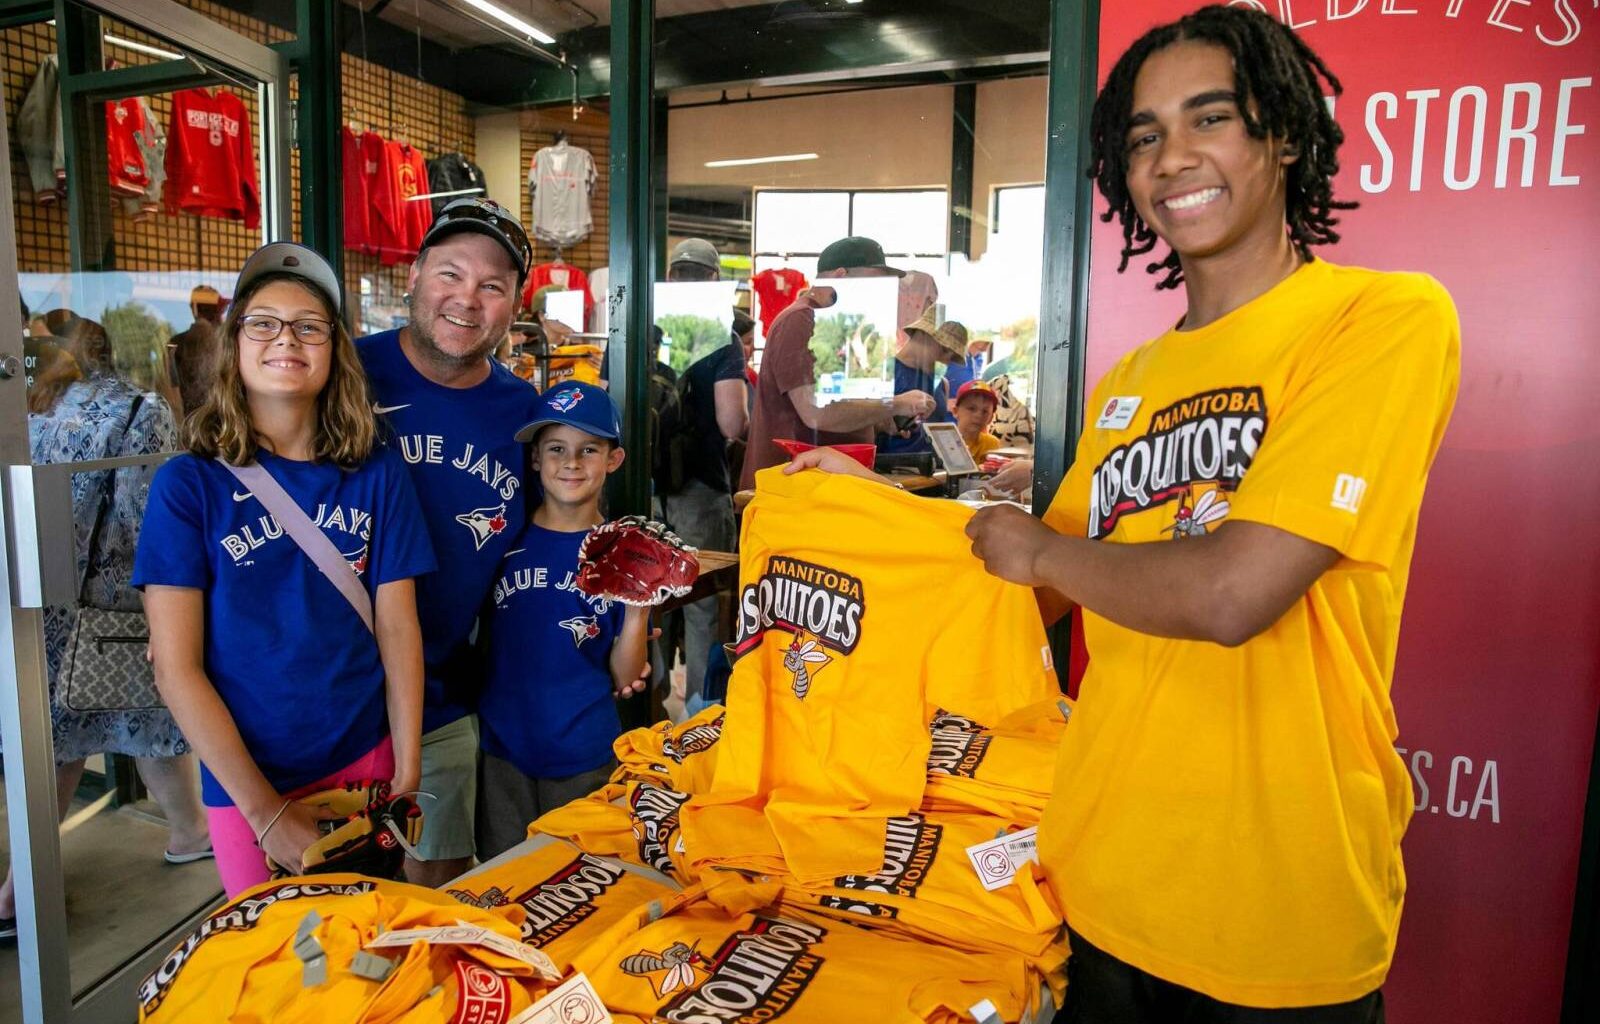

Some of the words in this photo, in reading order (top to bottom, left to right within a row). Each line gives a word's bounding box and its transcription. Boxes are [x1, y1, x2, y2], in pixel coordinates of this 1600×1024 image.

[1360, 77, 1592, 193] STORE
[1153, 392, 1261, 432] MANITOBA
[400, 435, 444, 464] UE
[452, 443, 520, 500] JAYS
[220, 515, 289, 562] BLU
[494, 568, 548, 604] BLUE
[772, 560, 860, 600] MANITOBA
[1394, 747, 1500, 824] S.CA
